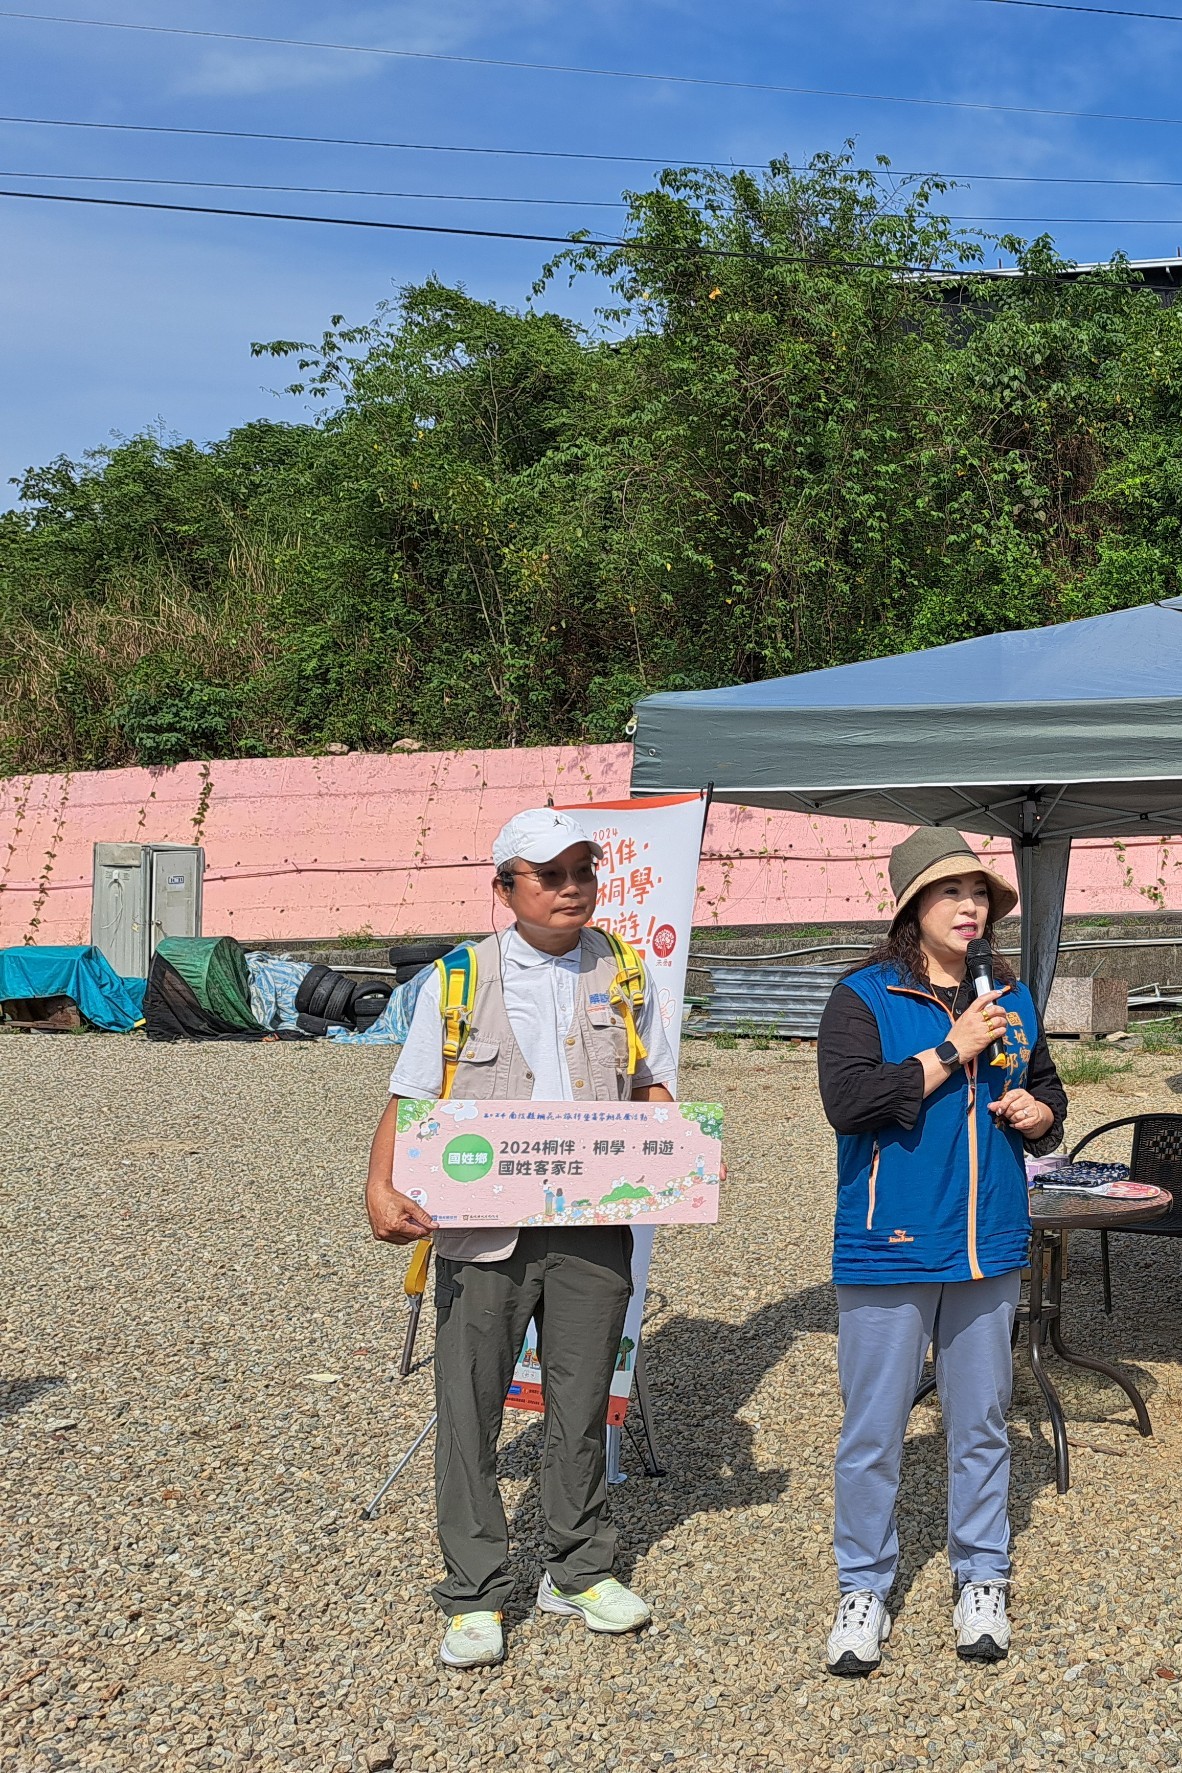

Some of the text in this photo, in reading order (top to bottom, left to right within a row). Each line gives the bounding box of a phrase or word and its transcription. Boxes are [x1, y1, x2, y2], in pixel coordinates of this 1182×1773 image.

[593, 828, 618, 842] 2024
[448, 1152, 488, 1165] 國姓鄉
[498, 1160, 584, 1176] 國姓客家庄
